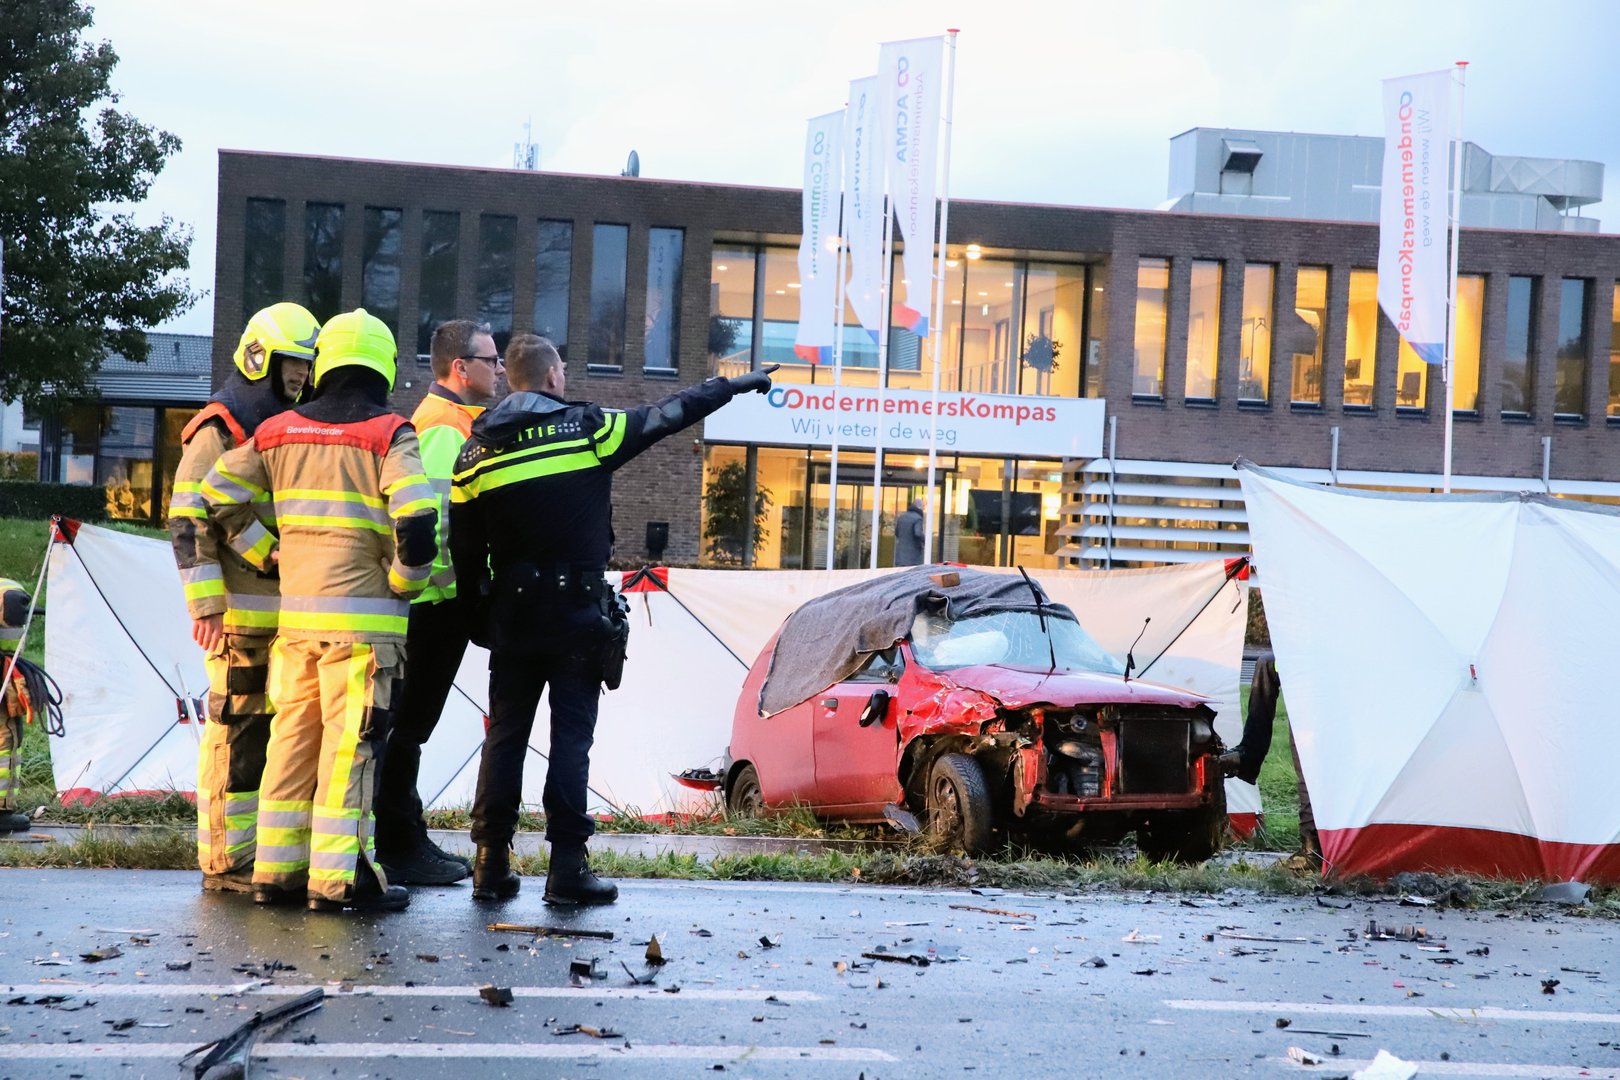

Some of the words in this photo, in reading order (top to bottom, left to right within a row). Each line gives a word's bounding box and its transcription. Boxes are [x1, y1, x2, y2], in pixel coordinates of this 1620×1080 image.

[286, 425, 345, 436] Bevelvoerder
[791, 417, 821, 440] Wij
[889, 421, 913, 439] de
[919, 426, 957, 446] weg
